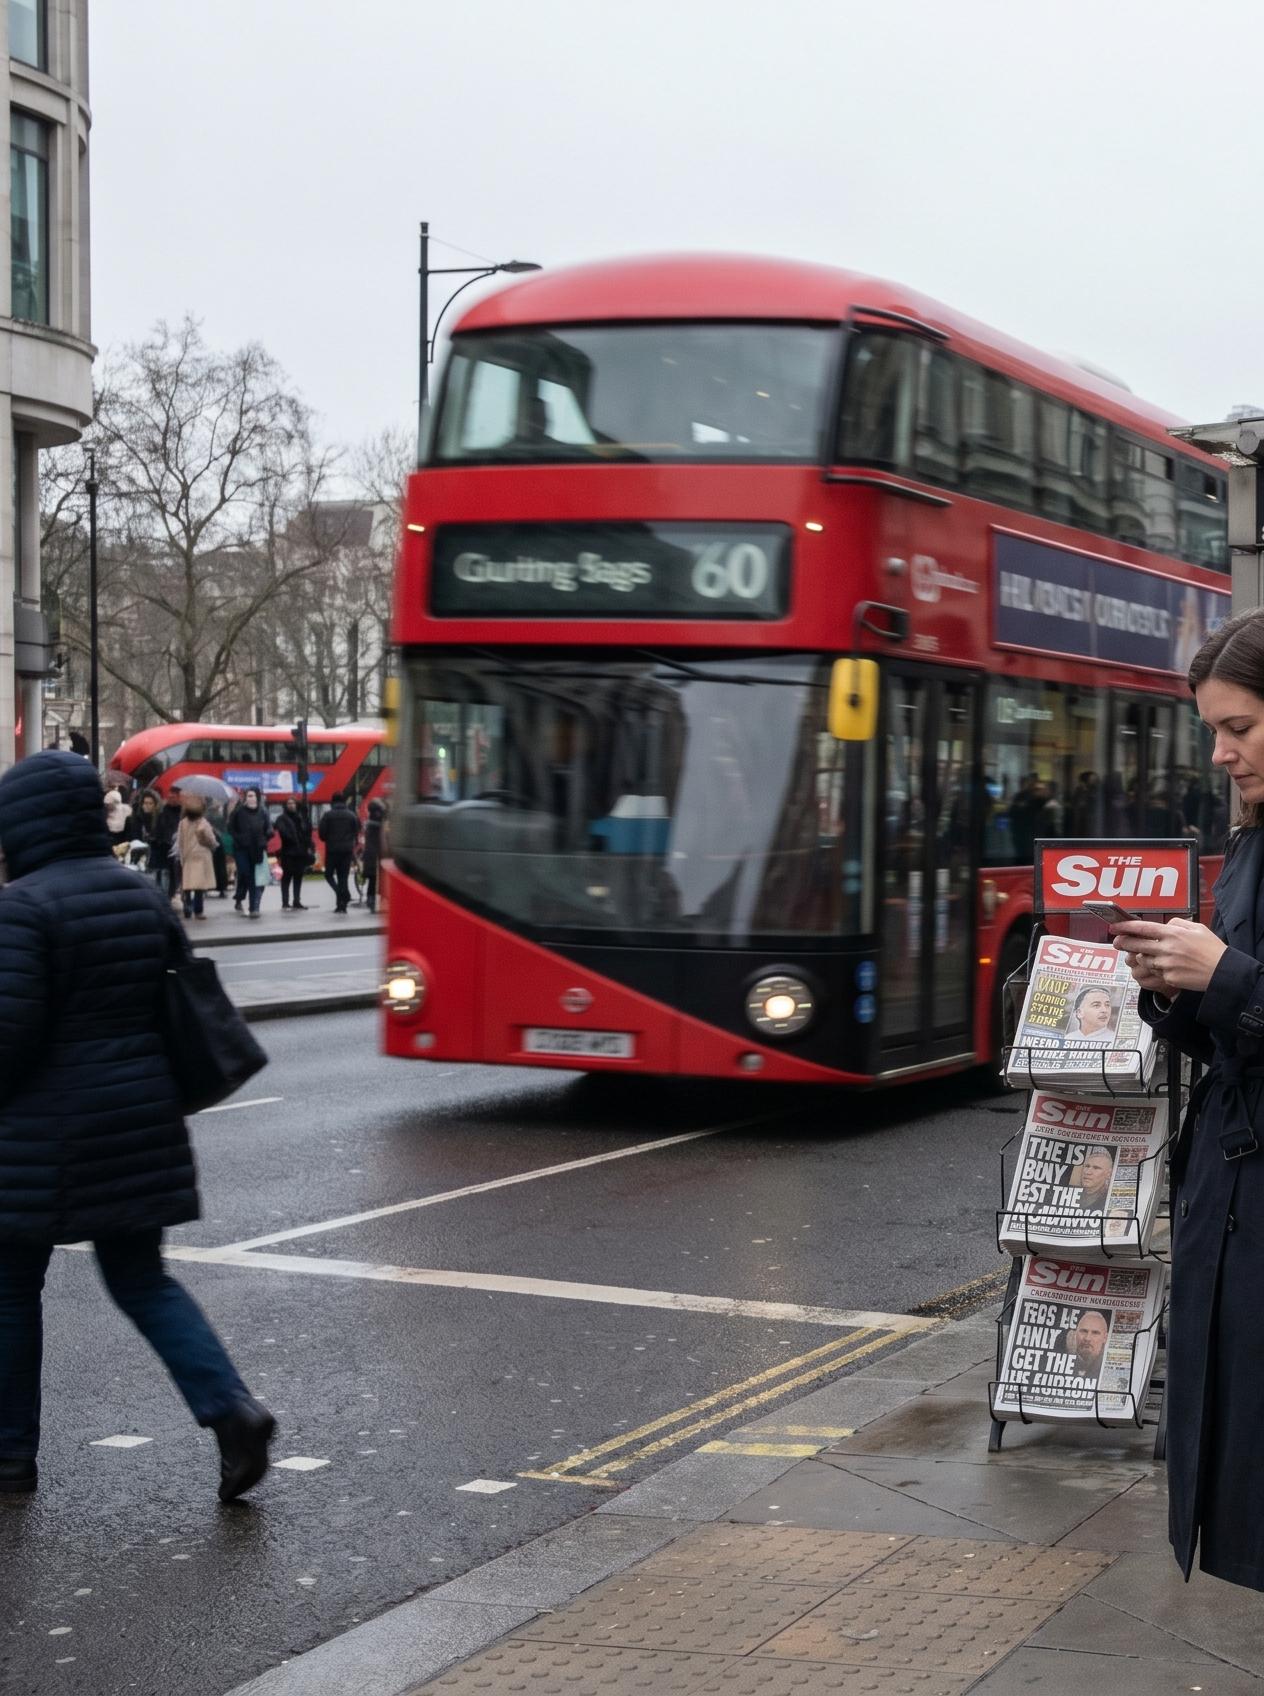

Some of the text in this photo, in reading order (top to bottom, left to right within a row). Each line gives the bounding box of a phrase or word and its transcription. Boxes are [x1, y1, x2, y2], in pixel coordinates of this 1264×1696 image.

[691, 542, 768, 598] 60
[1107, 856, 1143, 866] THE
[1050, 854, 1179, 897] Sun
[1043, 943, 1114, 970] Sun
[1036, 1100, 1111, 1129] Sun
[1029, 1137, 1065, 1162] THE
[1051, 1185, 1084, 1207] THE
[1029, 1260, 1105, 1292] Sun
[1045, 1352, 1077, 1375] THE
